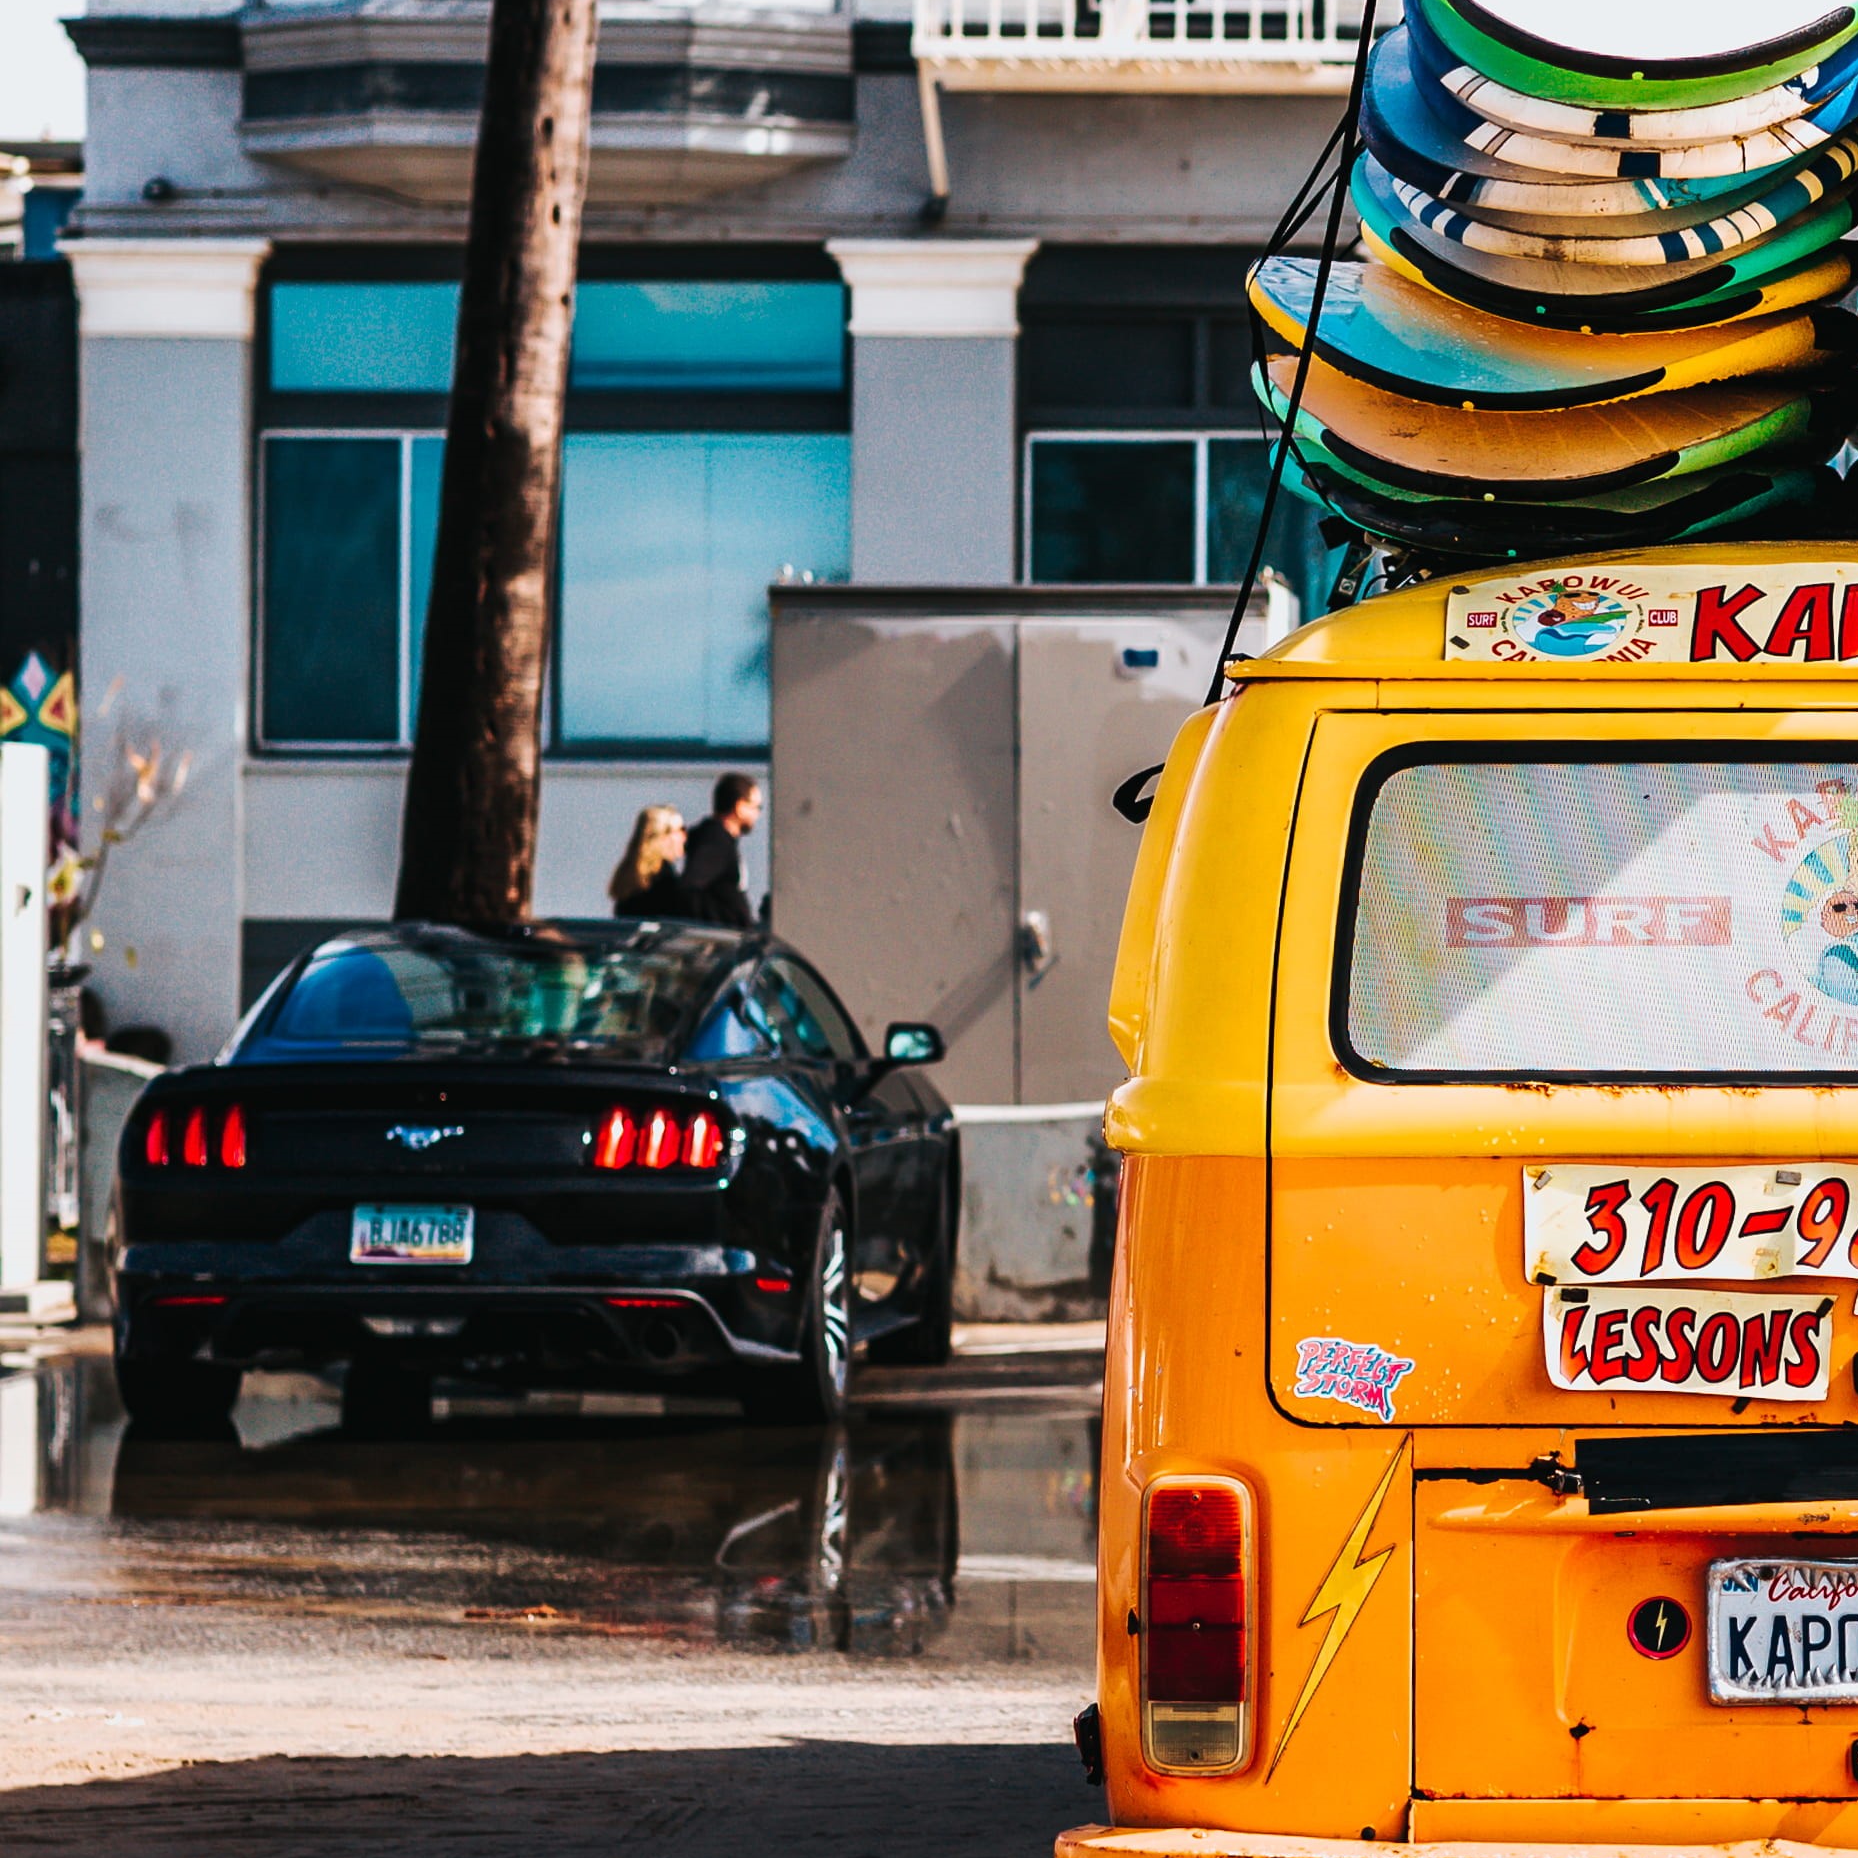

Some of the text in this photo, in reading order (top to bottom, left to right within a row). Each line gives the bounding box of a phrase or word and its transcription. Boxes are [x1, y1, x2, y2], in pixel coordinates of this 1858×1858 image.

[1495, 575, 1650, 604] KAPOWUI
[1467, 613, 1496, 627] SURF
[1649, 611, 1677, 624] CLUB
[1490, 638, 1657, 661] CANIA
[1462, 904, 1712, 941] SURF
[1558, 1303, 1824, 1390] LESSONS
[1299, 1340, 1413, 1388] PERFECT
[1297, 1363, 1393, 1421] STORM
